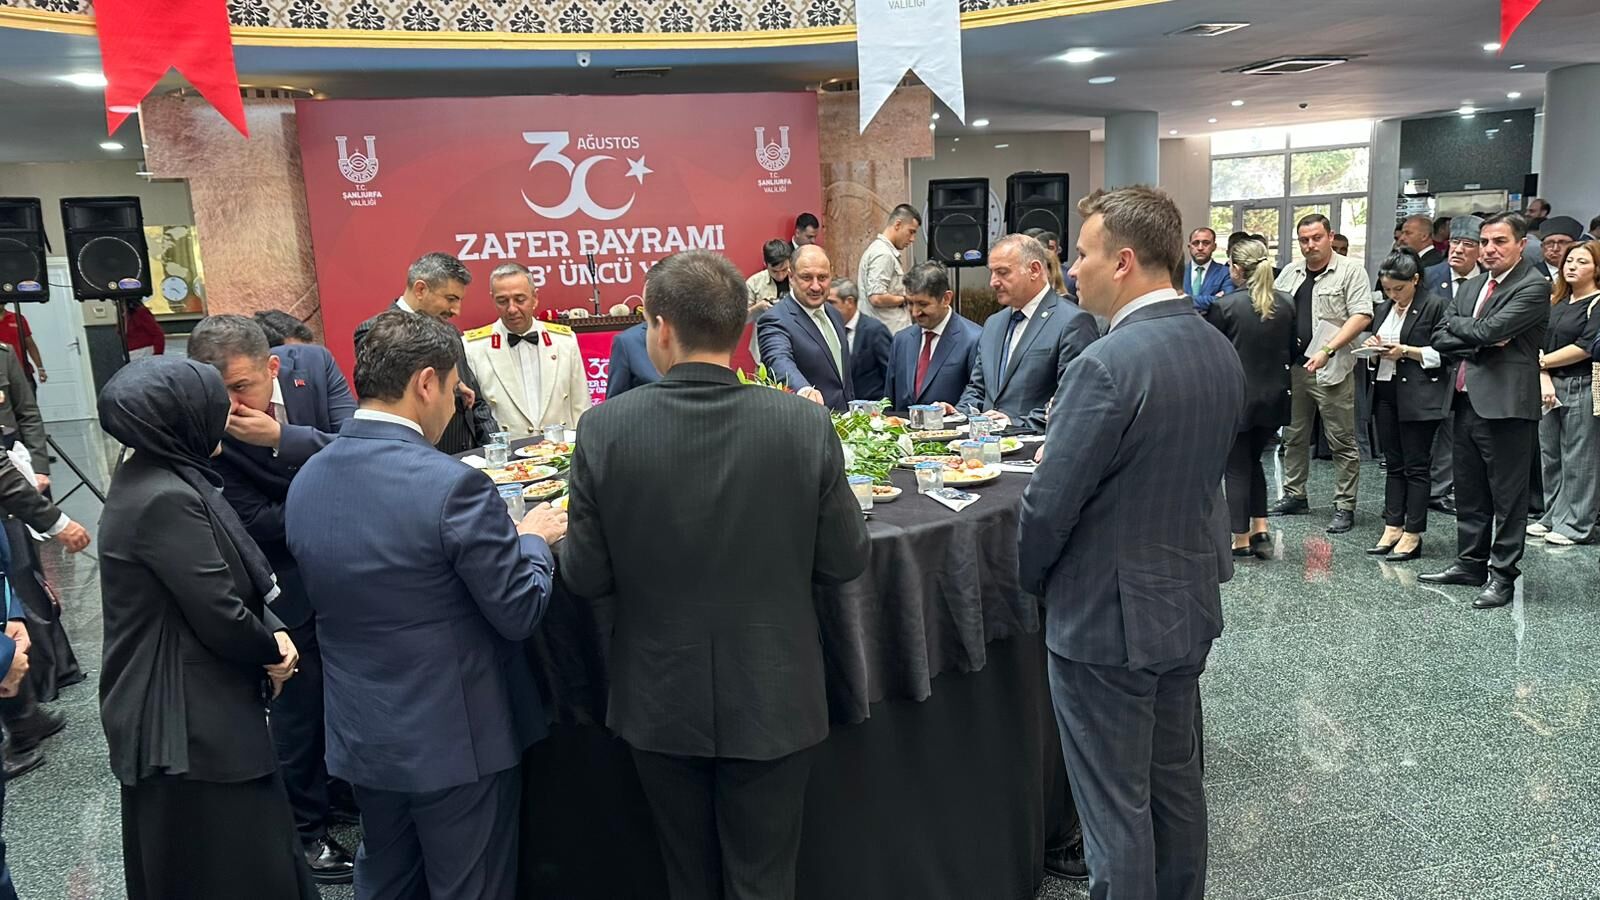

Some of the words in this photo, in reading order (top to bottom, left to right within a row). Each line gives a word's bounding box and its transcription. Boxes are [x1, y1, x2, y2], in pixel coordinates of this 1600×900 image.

[577, 134, 640, 150] AĞUSTOS
[342, 191, 383, 201] ŞANLIURFA
[455, 230, 571, 261] ZAFER
[577, 224, 725, 256] BAYRAMI
[558, 257, 633, 286] ÜNCÜ
